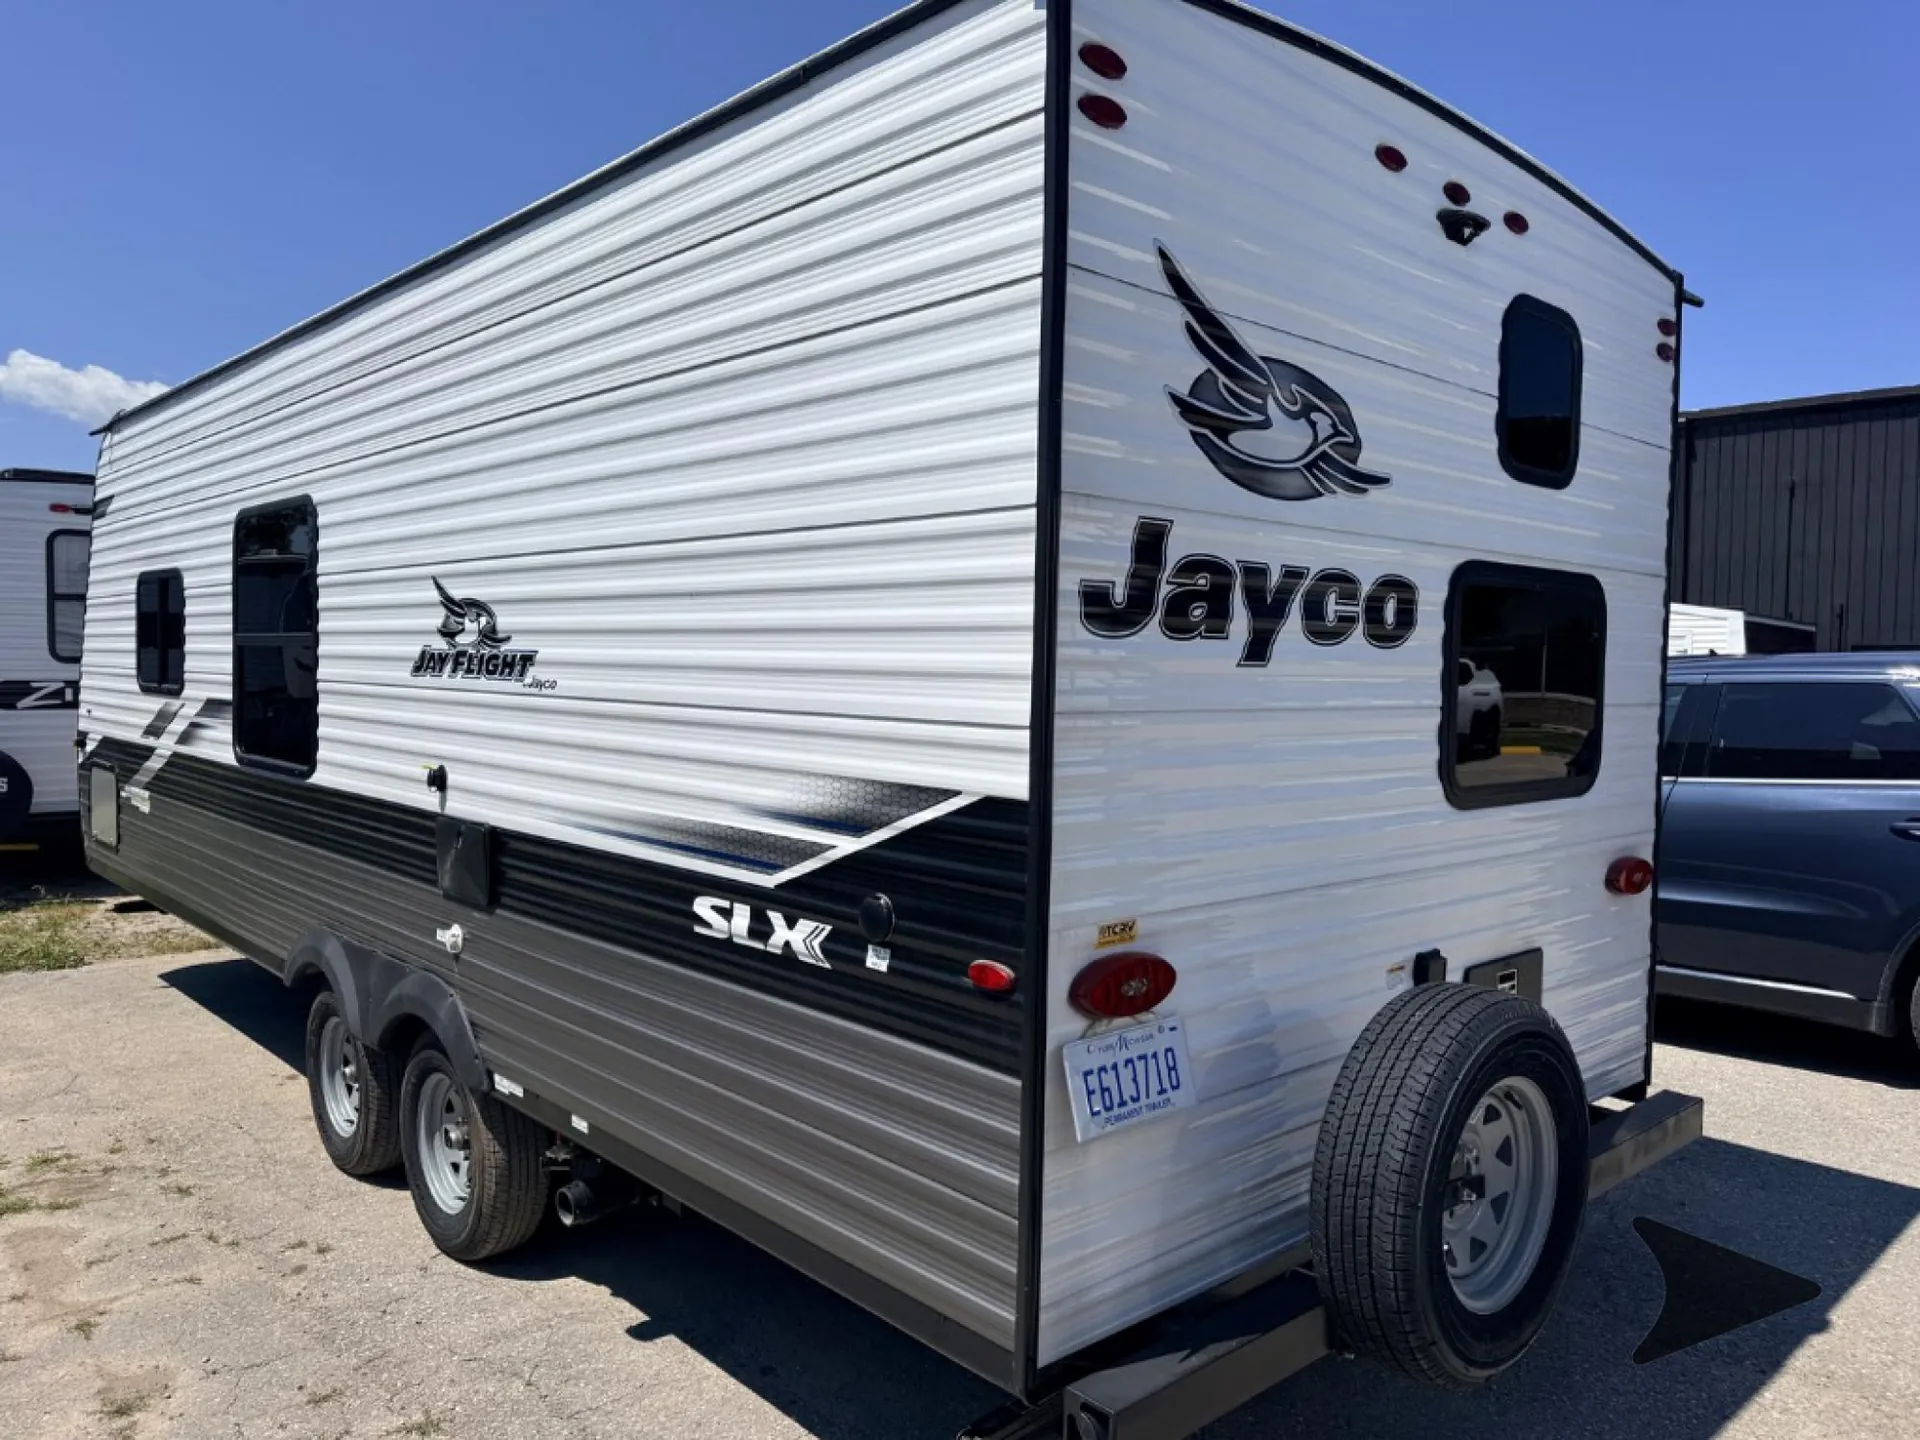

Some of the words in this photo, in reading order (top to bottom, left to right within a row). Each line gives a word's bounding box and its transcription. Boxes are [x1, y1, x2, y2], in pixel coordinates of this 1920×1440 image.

[1078, 515, 1420, 668] Jayco
[411, 644, 452, 677] JAY
[447, 648, 539, 683] FLIGHT
[692, 895, 833, 970] SLX
[1082, 1046, 1181, 1118] E613718
